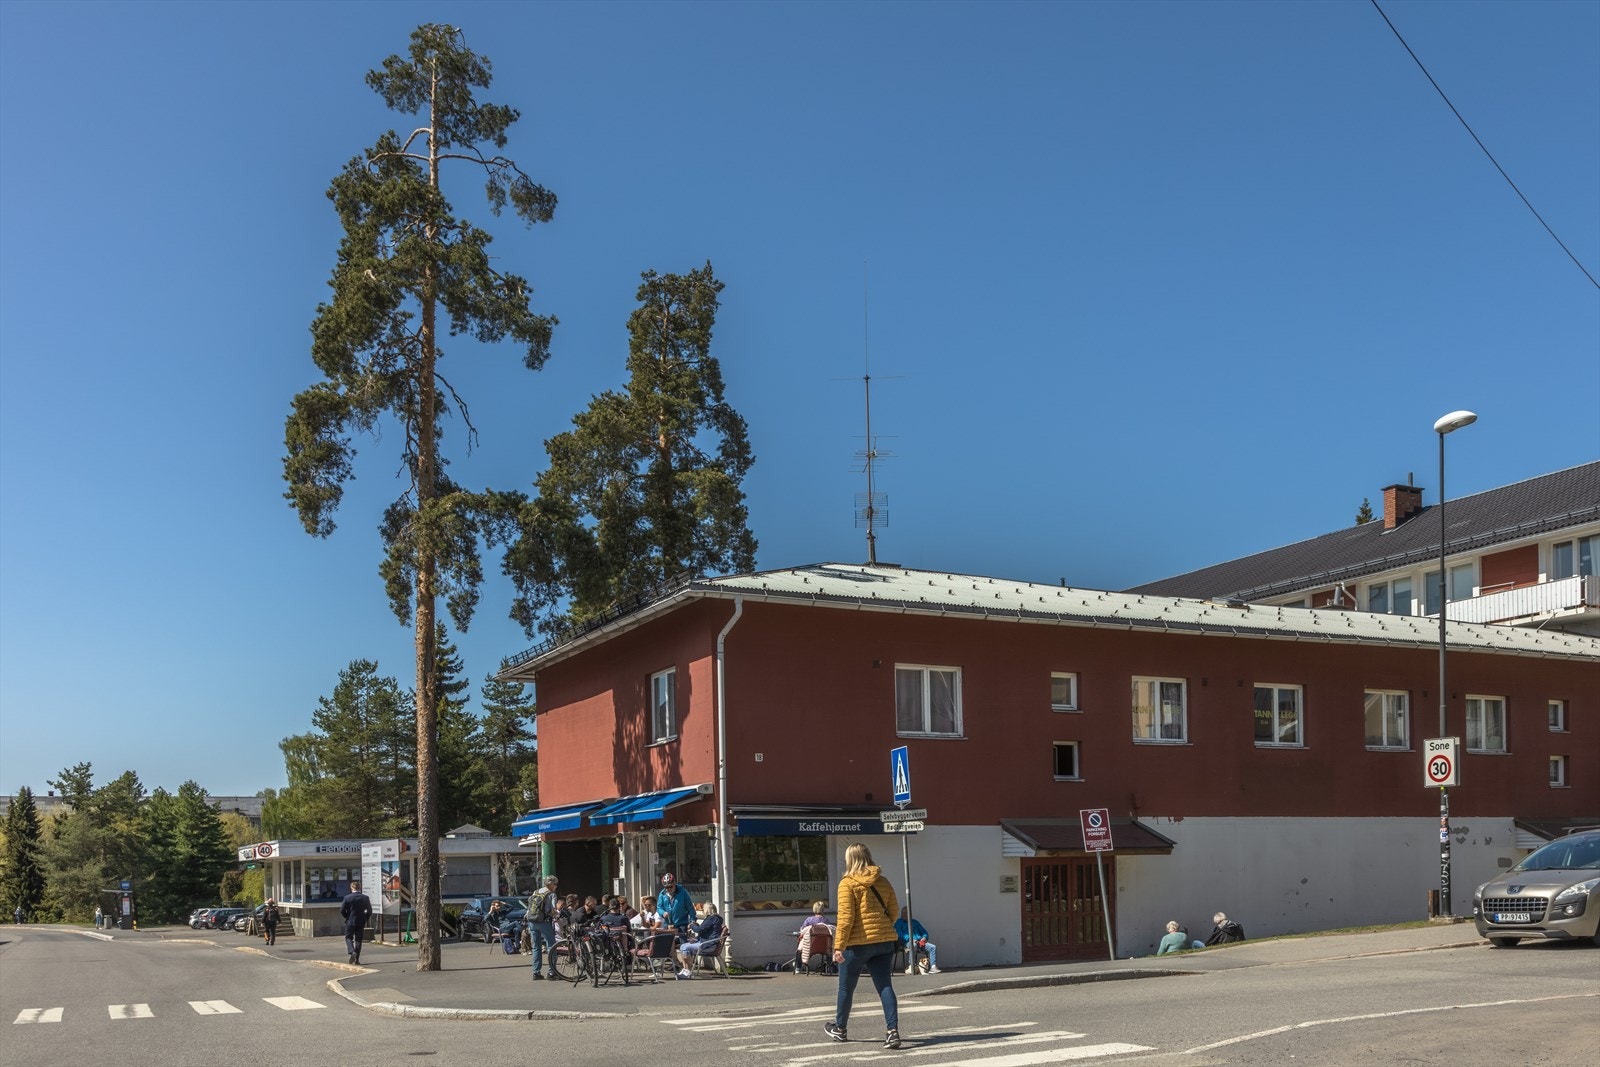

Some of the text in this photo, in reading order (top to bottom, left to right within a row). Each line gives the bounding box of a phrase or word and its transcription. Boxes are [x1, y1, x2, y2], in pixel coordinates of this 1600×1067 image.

[1429, 742, 1450, 751] Sone
[1432, 761, 1448, 776] 30
[883, 811, 926, 820] Selvbyggerveien
[799, 822, 861, 833] Kaffehjørnet
[260, 846, 270, 855] 40
[751, 883, 825, 894] KAFFEHJØRNET
